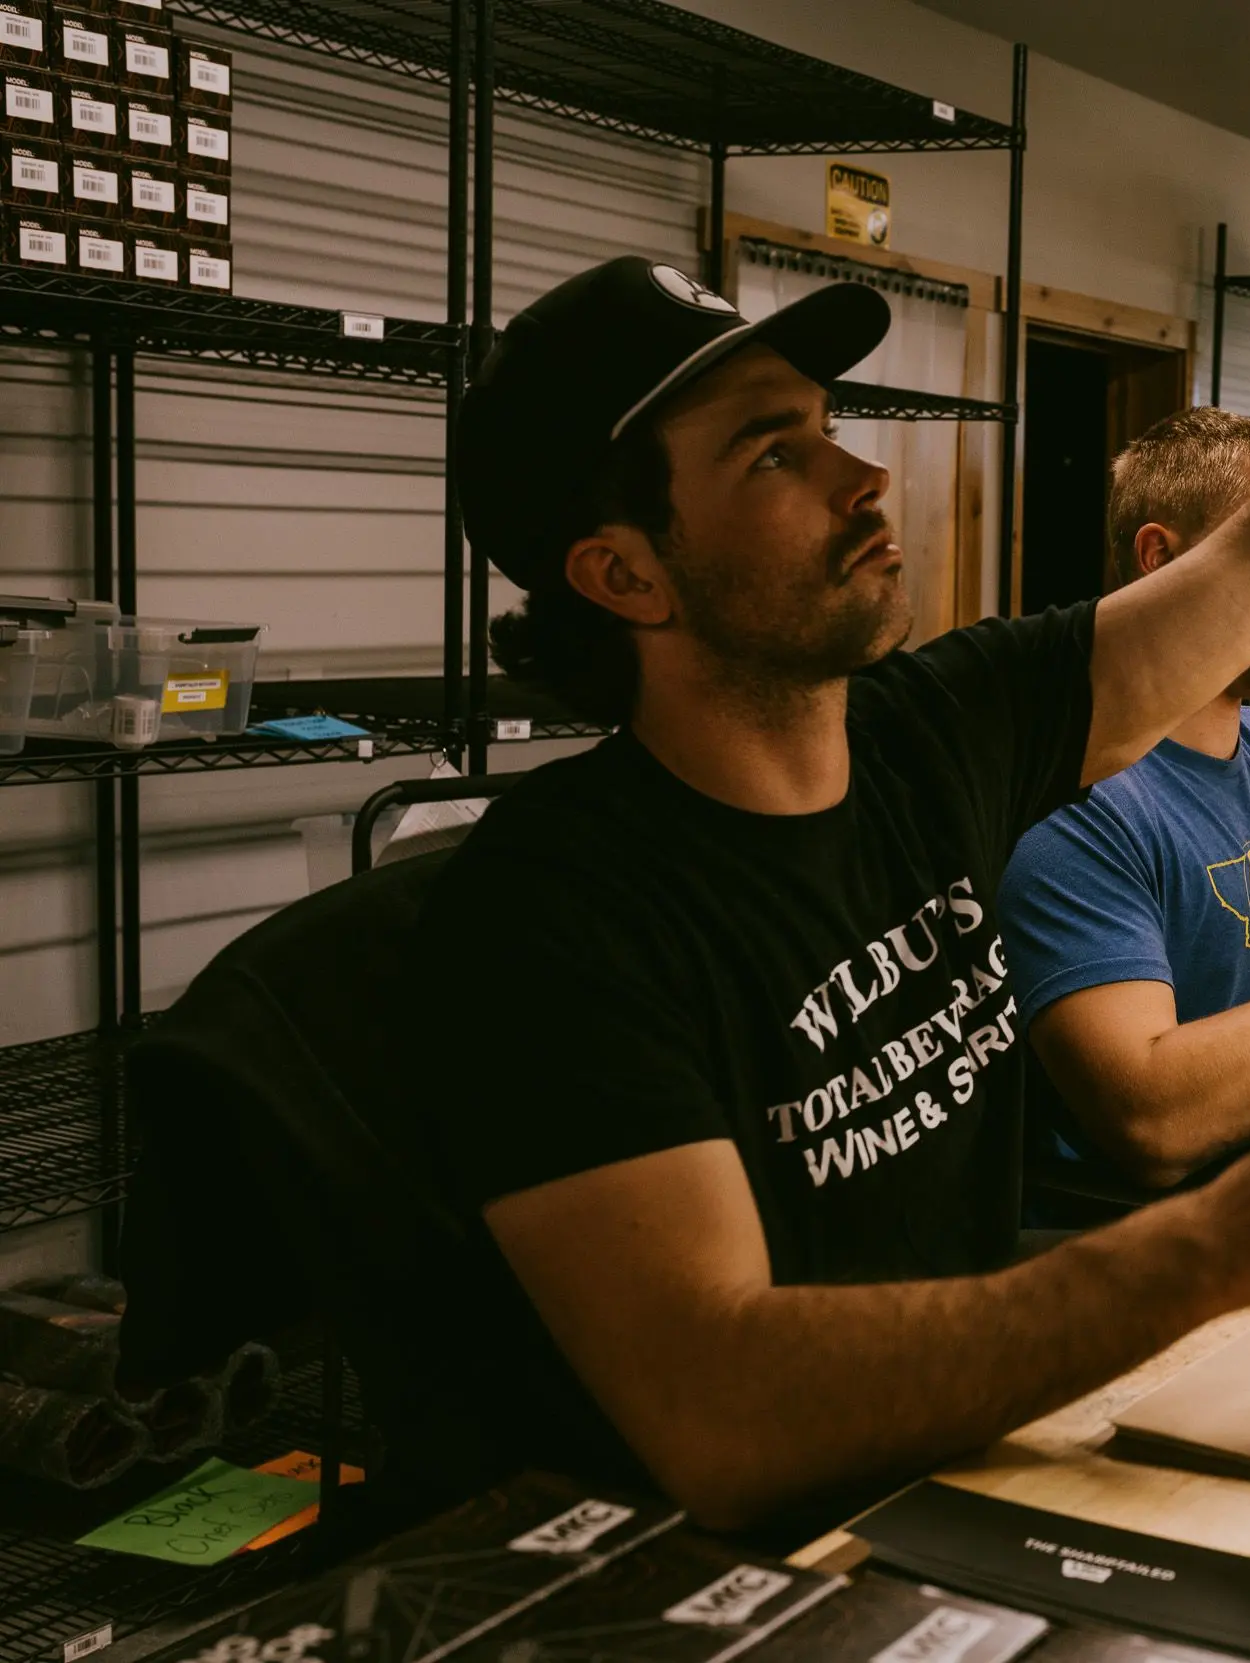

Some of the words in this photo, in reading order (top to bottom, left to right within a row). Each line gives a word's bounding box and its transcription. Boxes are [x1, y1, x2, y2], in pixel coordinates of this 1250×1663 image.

[832, 168, 887, 205] CAUTION
[767, 1056, 893, 1142] TOTAL
[803, 1107, 921, 1188] WINE
[915, 1091, 948, 1130] &
[1024, 1536, 1059, 1555] THE
